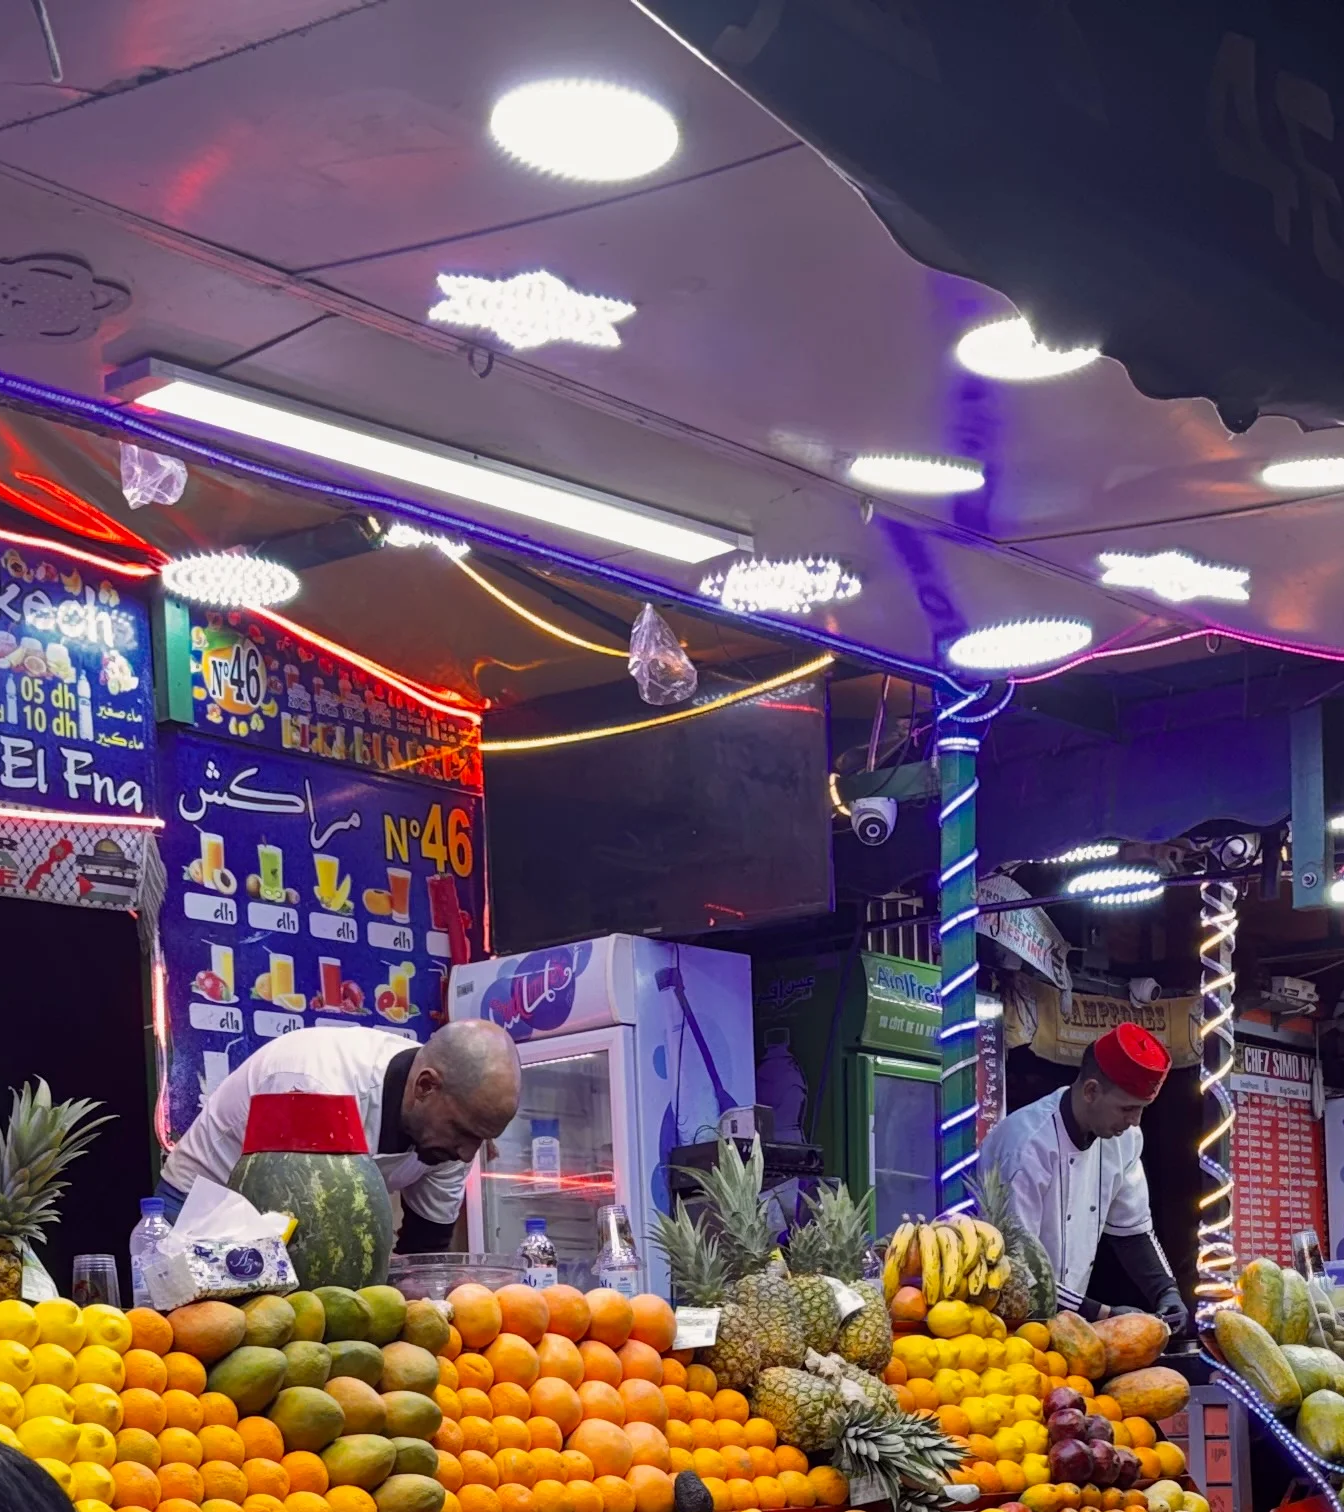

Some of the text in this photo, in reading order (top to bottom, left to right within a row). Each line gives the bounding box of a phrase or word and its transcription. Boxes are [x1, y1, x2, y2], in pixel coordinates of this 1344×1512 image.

[210, 645, 262, 706] N°46
[20, 676, 46, 703] 05
[51, 682, 77, 711] dh
[23, 706, 47, 733] 10
[52, 713, 78, 740] dh
[0, 734, 48, 794] El
[59, 746, 144, 814] Fna
[179, 760, 362, 849] مراكش
[383, 804, 474, 878] N°46
[213, 903, 234, 922] dh
[276, 911, 296, 931] dh
[336, 922, 355, 940] dh
[393, 931, 411, 949] dh
[1244, 1047, 1271, 1075] CHEZ
[1272, 1051, 1300, 1080] SIMO
